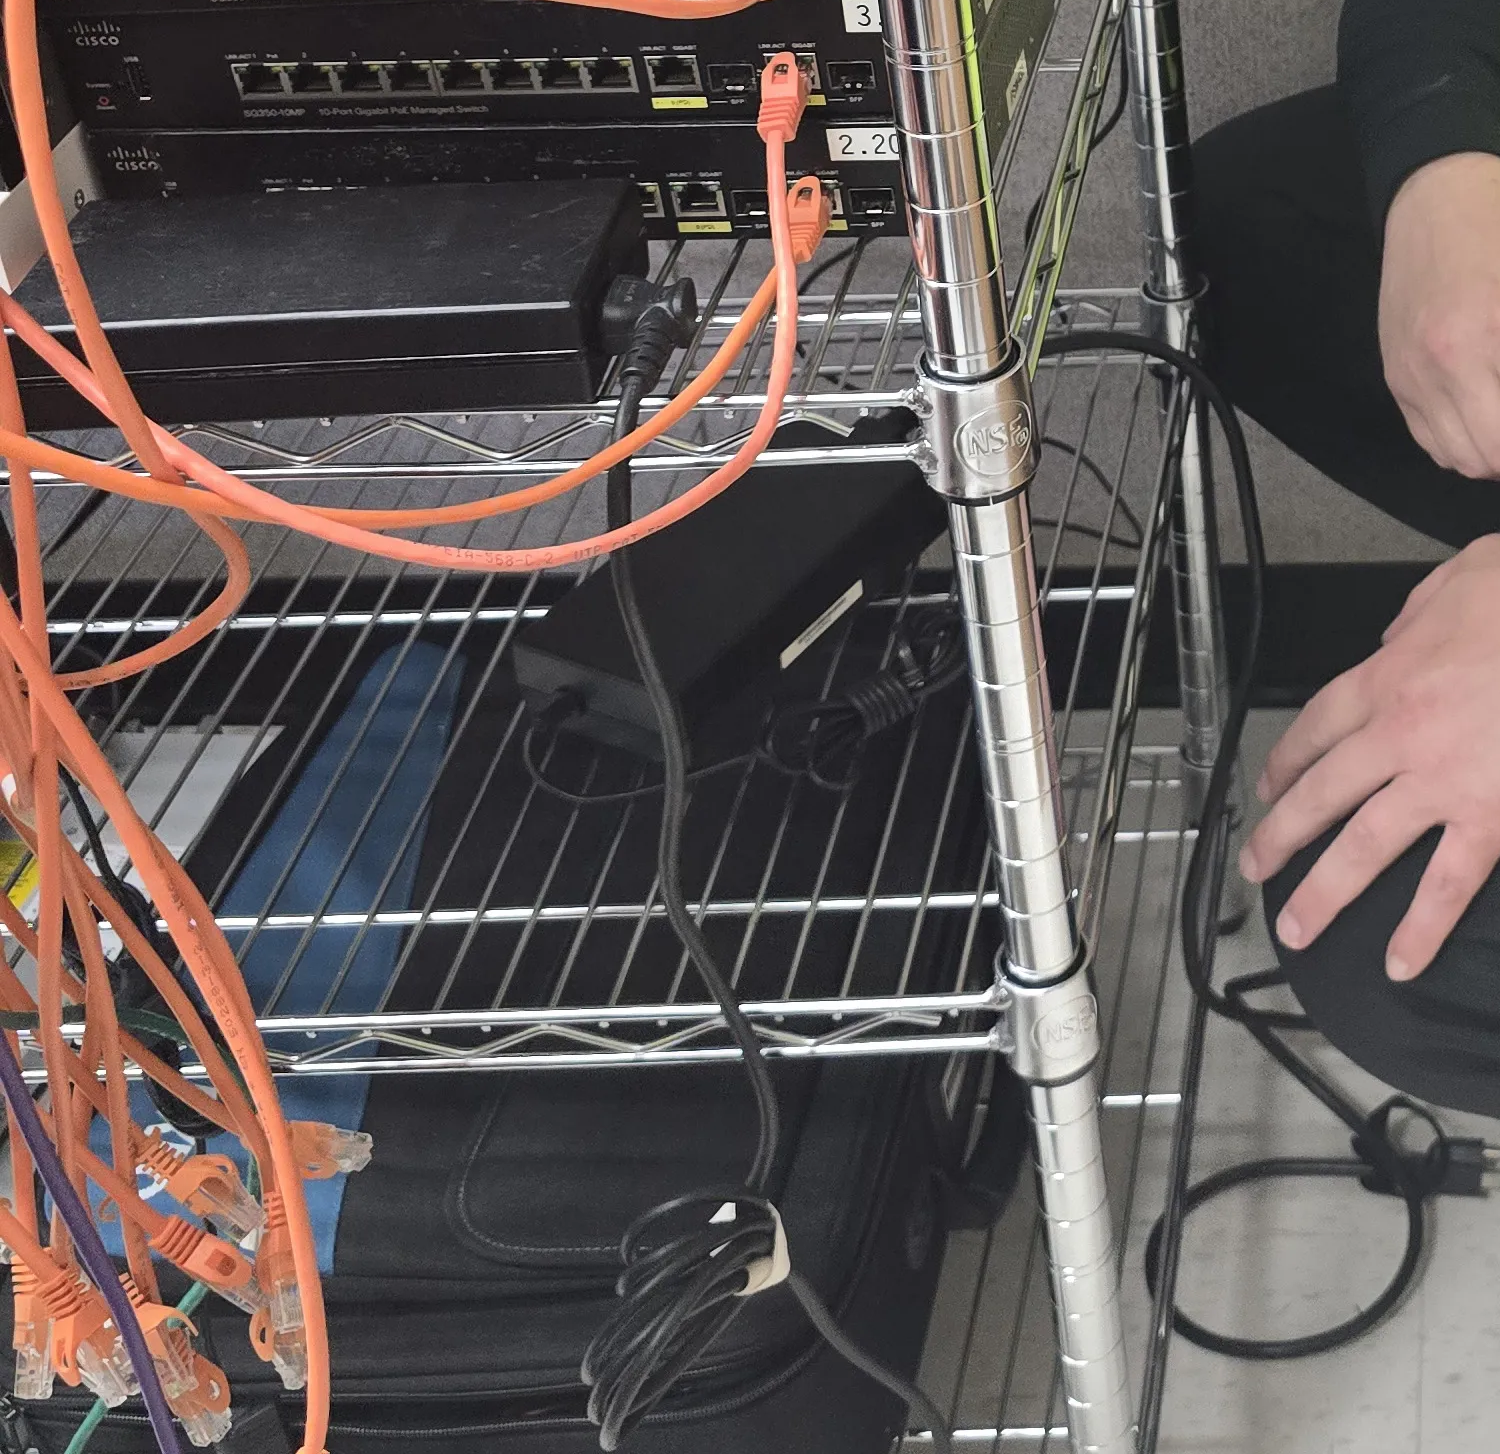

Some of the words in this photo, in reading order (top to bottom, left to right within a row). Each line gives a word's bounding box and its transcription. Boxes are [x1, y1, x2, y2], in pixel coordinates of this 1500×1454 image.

[318, 107, 353, 116] 10-Port
[354, 106, 389, 117] Gigabit
[410, 104, 455, 116] Managed
[456, 103, 489, 113] Switch
[838, 132, 900, 156] 2.20
